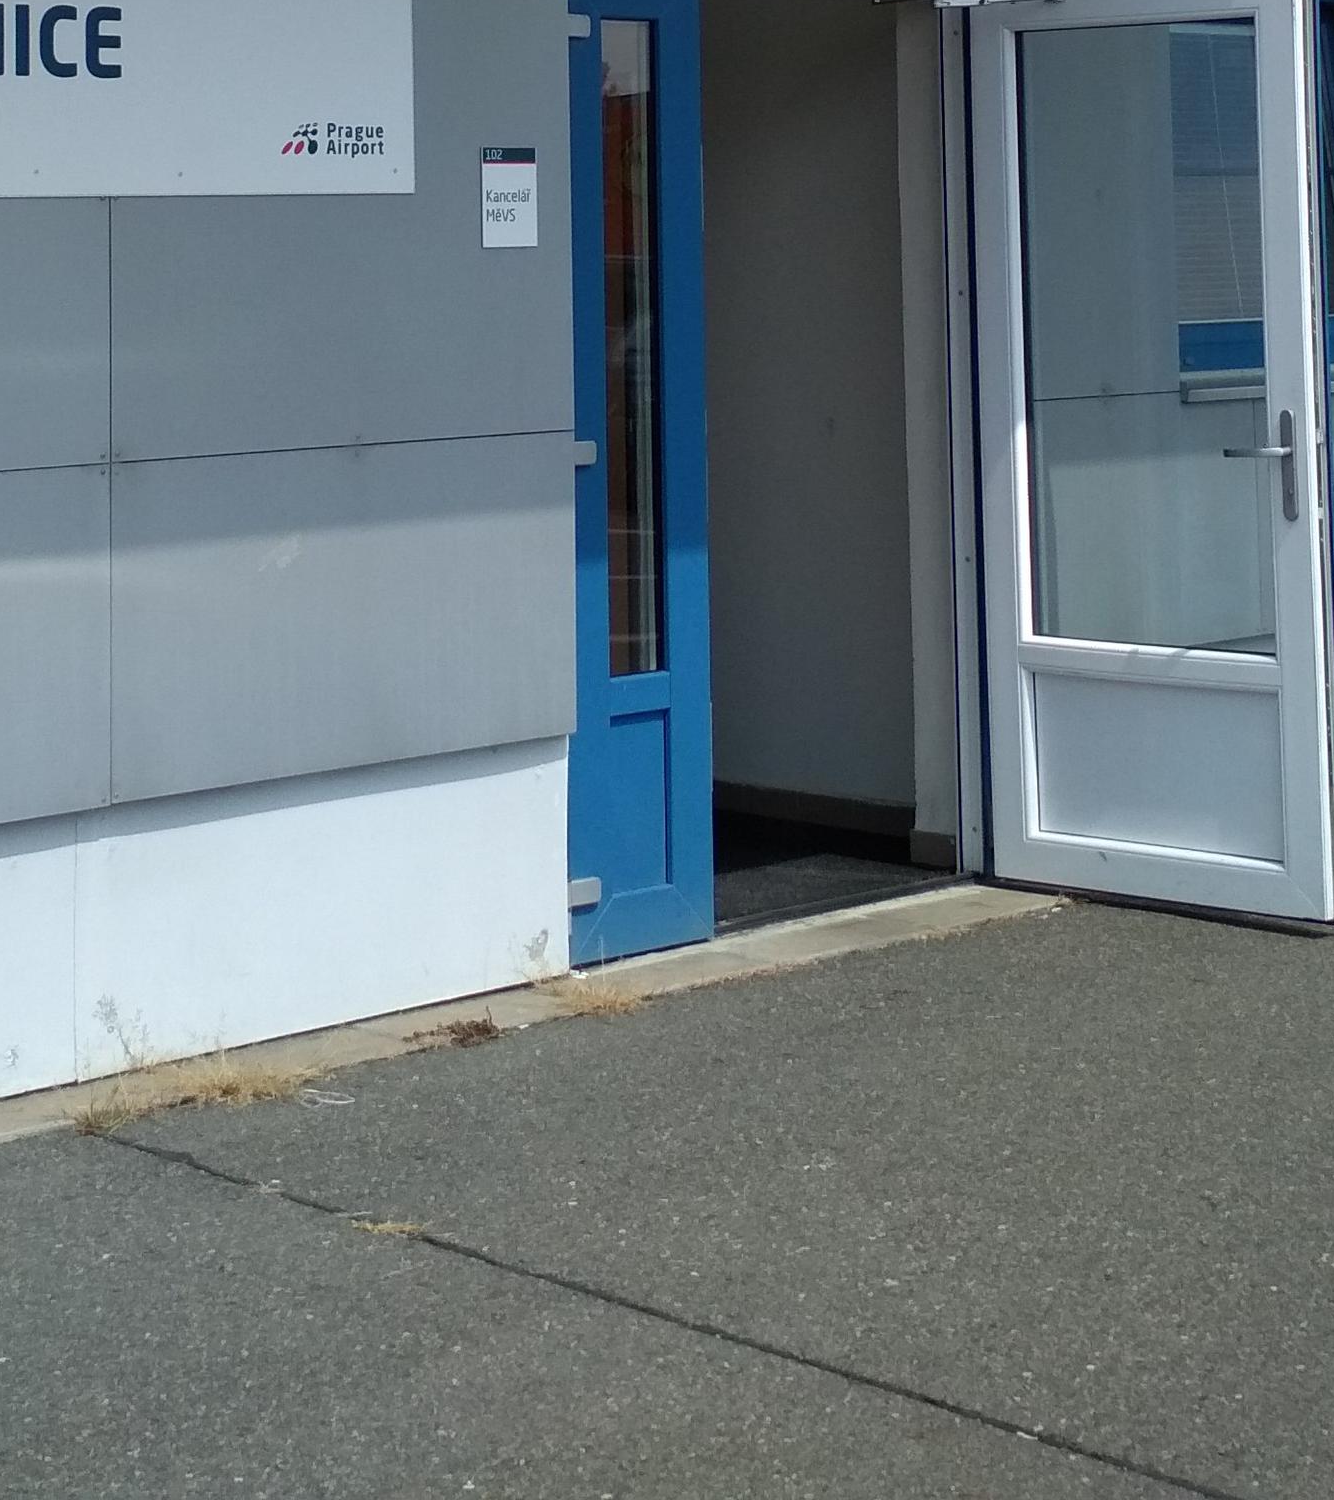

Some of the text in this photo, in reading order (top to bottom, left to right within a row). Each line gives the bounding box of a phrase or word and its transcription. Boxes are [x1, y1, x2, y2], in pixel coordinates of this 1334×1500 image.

[327, 122, 384, 142] Prague
[326, 139, 384, 158] Airport
[485, 149, 503, 160] 102
[486, 188, 532, 203] Kancelář
[486, 207, 516, 222] MěVS
